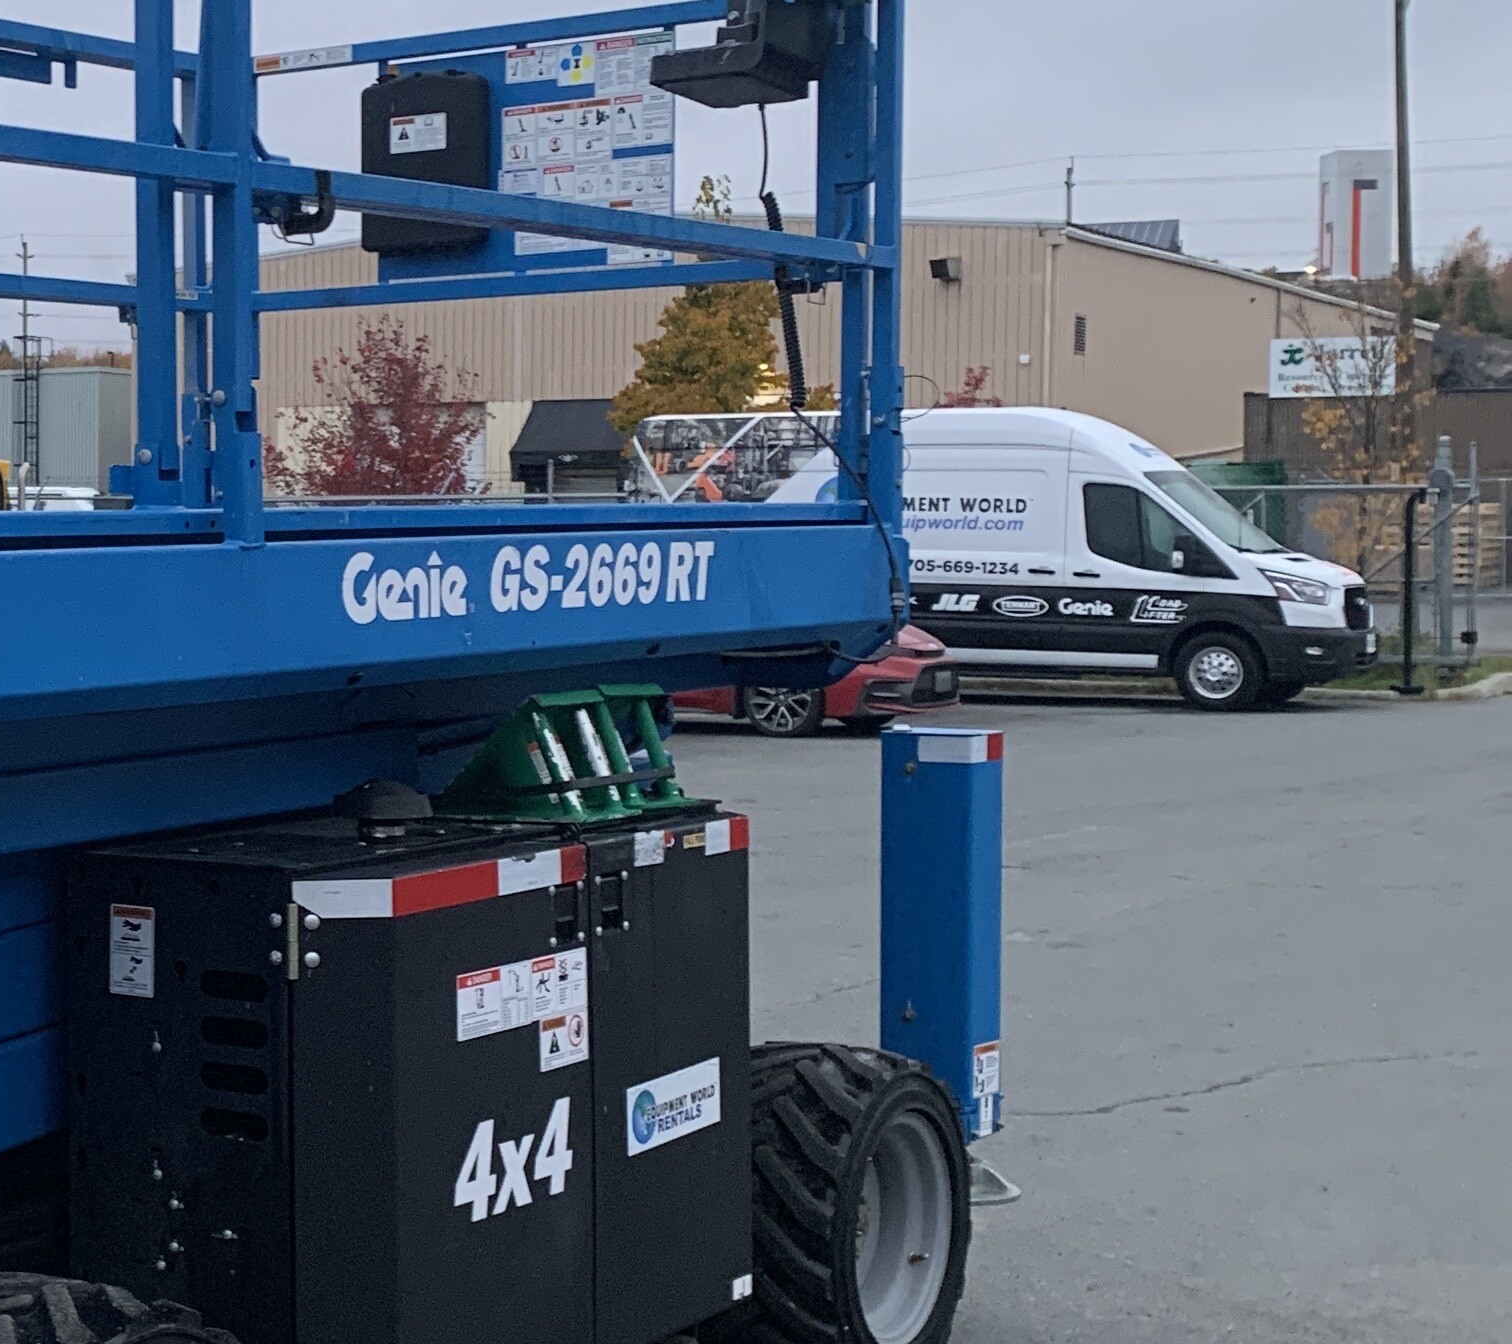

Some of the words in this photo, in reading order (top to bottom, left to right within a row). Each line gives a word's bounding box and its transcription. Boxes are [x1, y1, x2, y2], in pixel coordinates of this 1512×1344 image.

[959, 498, 1028, 513] WORLD
[342, 550, 468, 625] Genie
[931, 593, 981, 612] JLG
[1058, 597, 1114, 616] Genie
[690, 1084, 716, 1104] WORLD
[658, 1104, 702, 1133] RENTALS
[453, 1096, 574, 1223] 4x4
